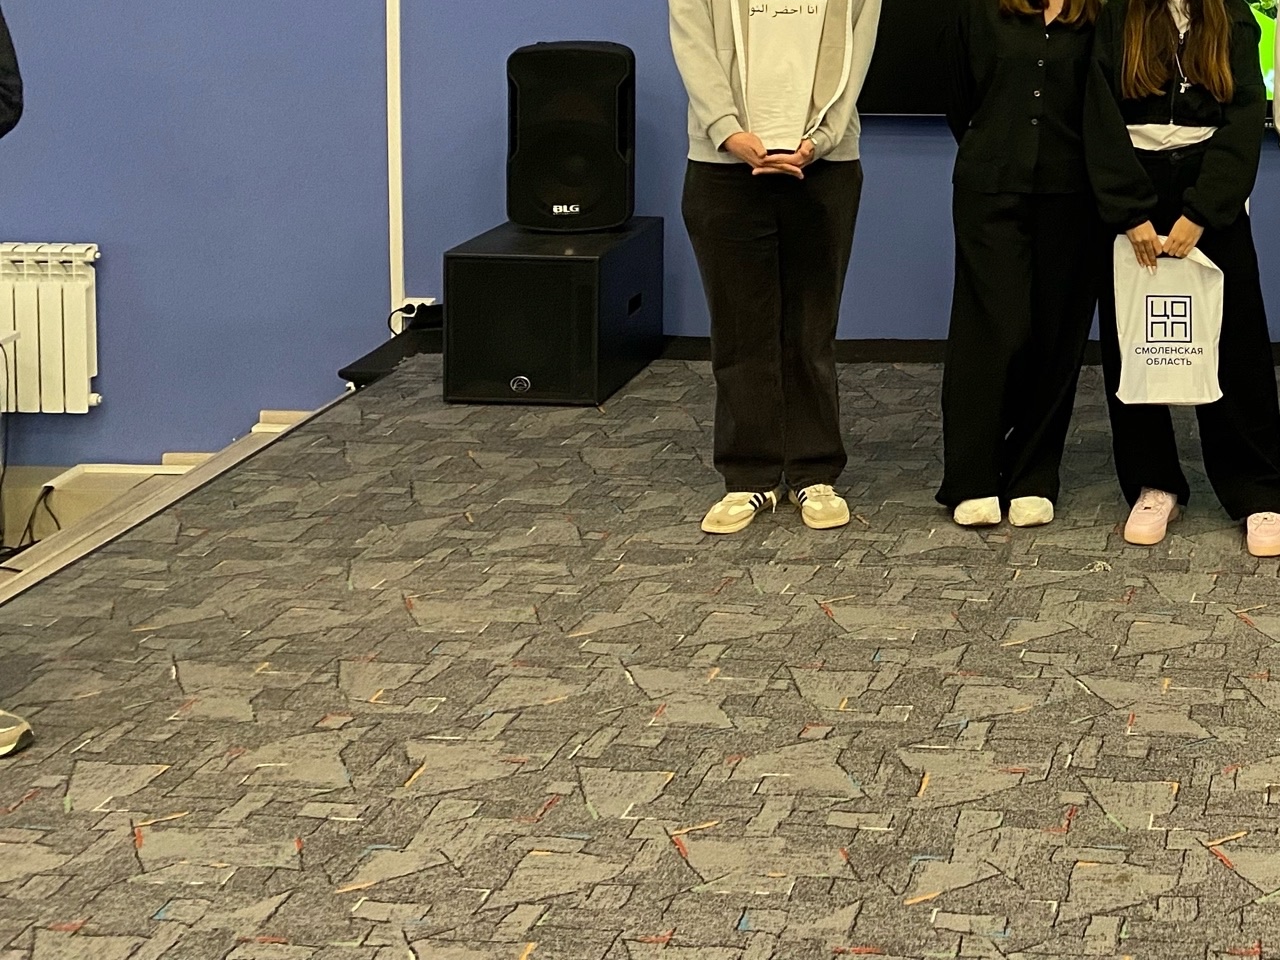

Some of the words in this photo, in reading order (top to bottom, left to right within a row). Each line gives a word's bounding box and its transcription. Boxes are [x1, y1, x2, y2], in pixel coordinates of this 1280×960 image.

[552, 204, 580, 213] BLG
[1134, 346, 1204, 355] СМОЛЕНСКАЯ
[1146, 357, 1193, 366] ОБЛАСТЬ
